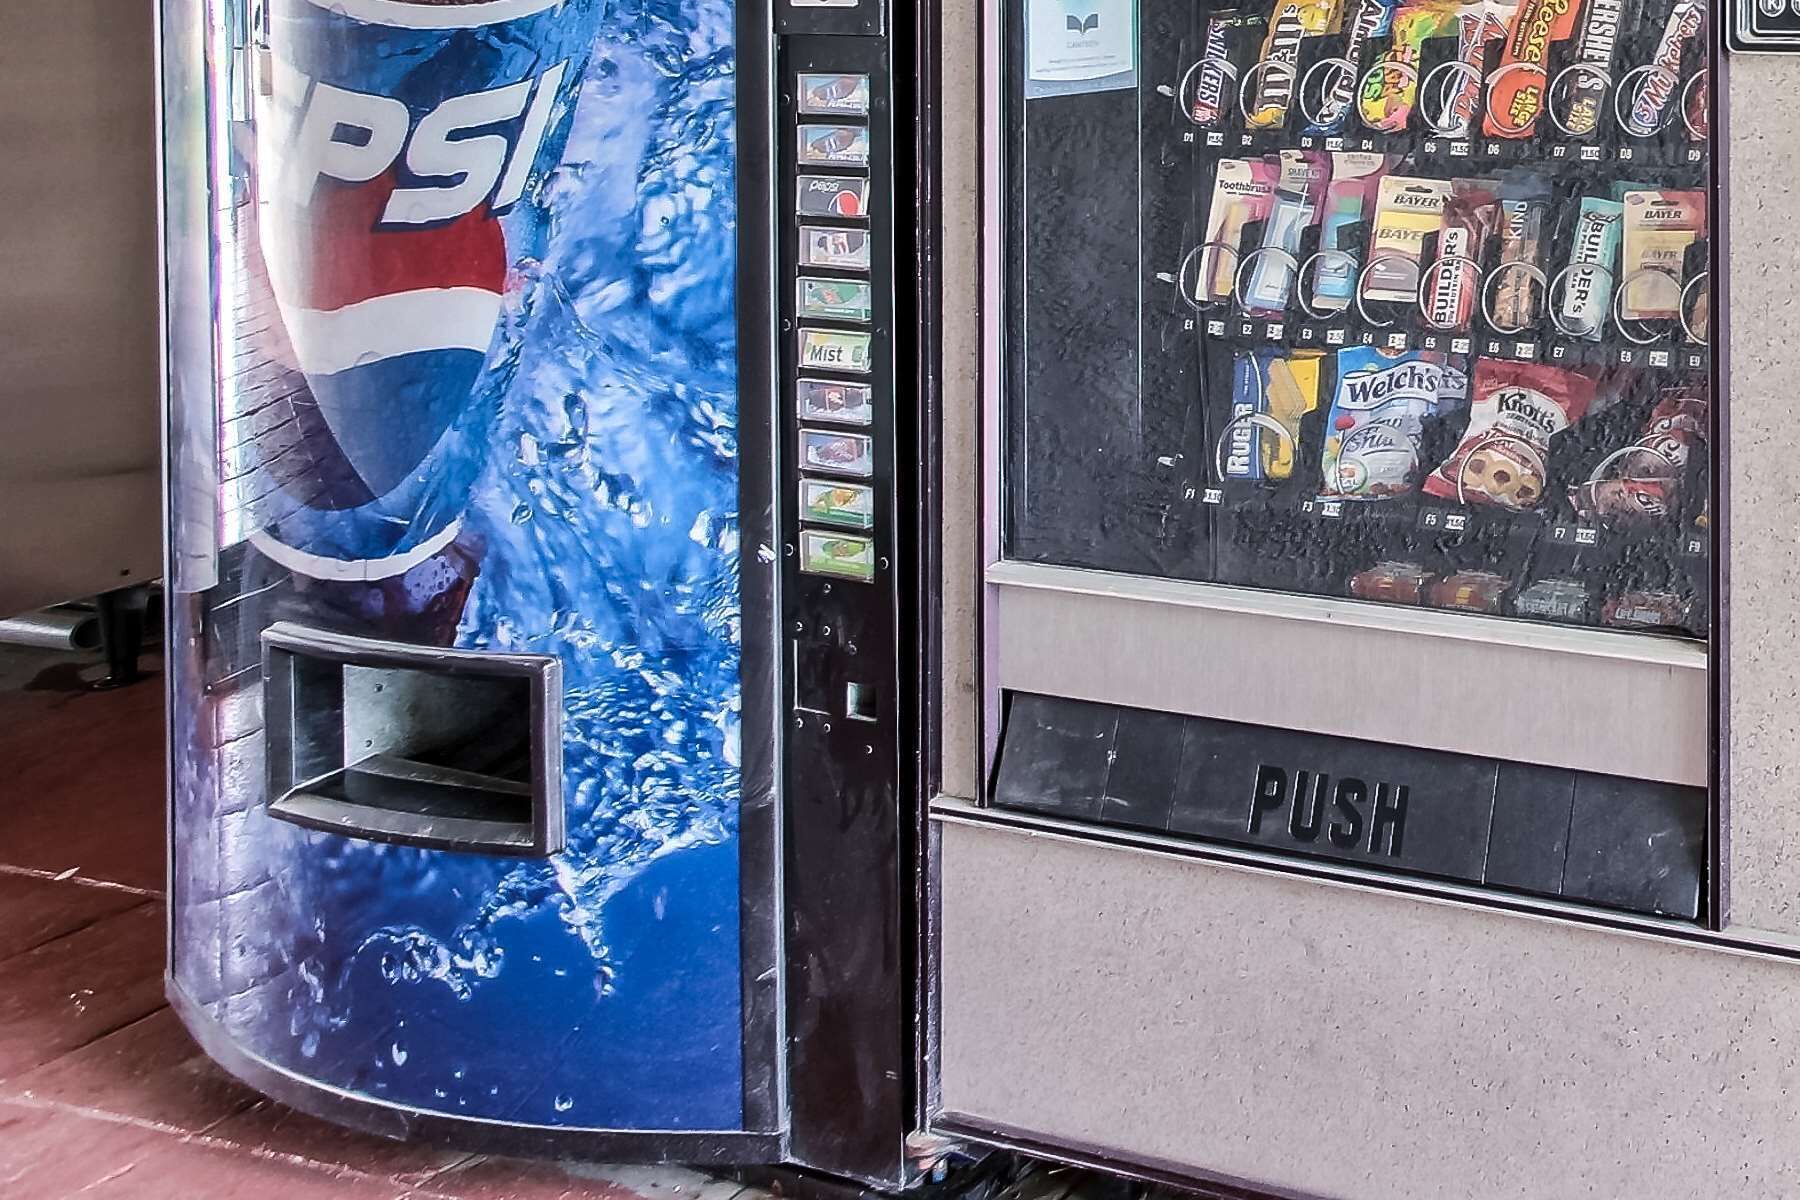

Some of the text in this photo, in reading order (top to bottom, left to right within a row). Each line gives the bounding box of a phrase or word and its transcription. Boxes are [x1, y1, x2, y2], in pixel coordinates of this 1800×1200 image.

[1508, 91, 1526, 116] SIZE
[1514, 85, 1540, 128] LARGE
[1393, 193, 1440, 208] BAYER
[1510, 200, 1528, 240] KIND
[1644, 209, 1683, 220] BAYER
[1378, 227, 1424, 241] BAYE
[1434, 231, 1459, 324] BUILDER'S
[809, 345, 843, 364] Mist
[1554, 347, 1565, 358] E7
[1346, 365, 1438, 405] Welch's
[1497, 391, 1556, 434] Knott's
[1226, 402, 1255, 476] RUGER
[1425, 514, 1437, 526] F5
[1554, 528, 1566, 540] F7
[1247, 764, 1410, 857] PUSH
